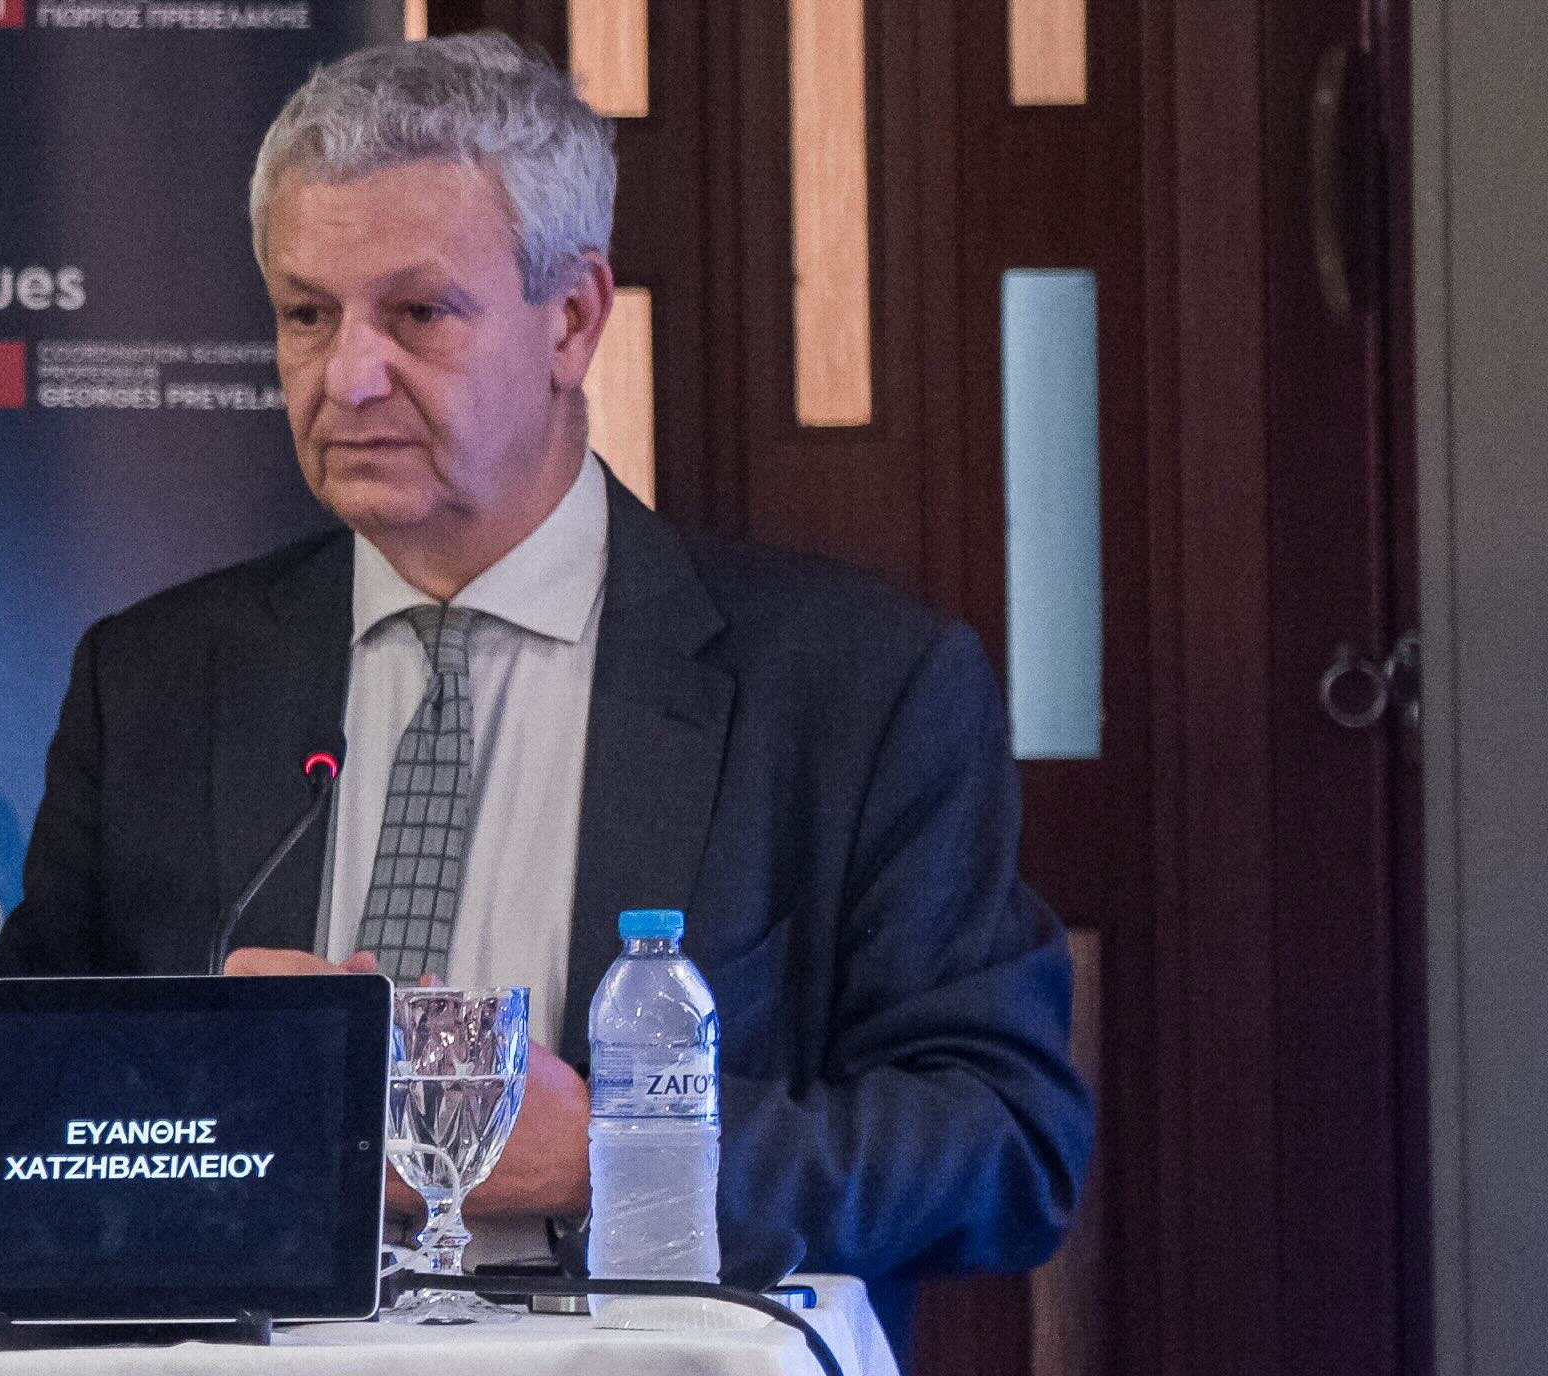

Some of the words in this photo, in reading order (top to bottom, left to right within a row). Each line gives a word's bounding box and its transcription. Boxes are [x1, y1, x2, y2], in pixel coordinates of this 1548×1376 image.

[646, 1074, 715, 1096] ΖΑΓΟ
[65, 1119, 217, 1146] ΕΥΑΝΘΗΣ
[4, 1152, 275, 1181] ΧΑΤΖΗΒΑΣΙΛΕΙΟΥ
